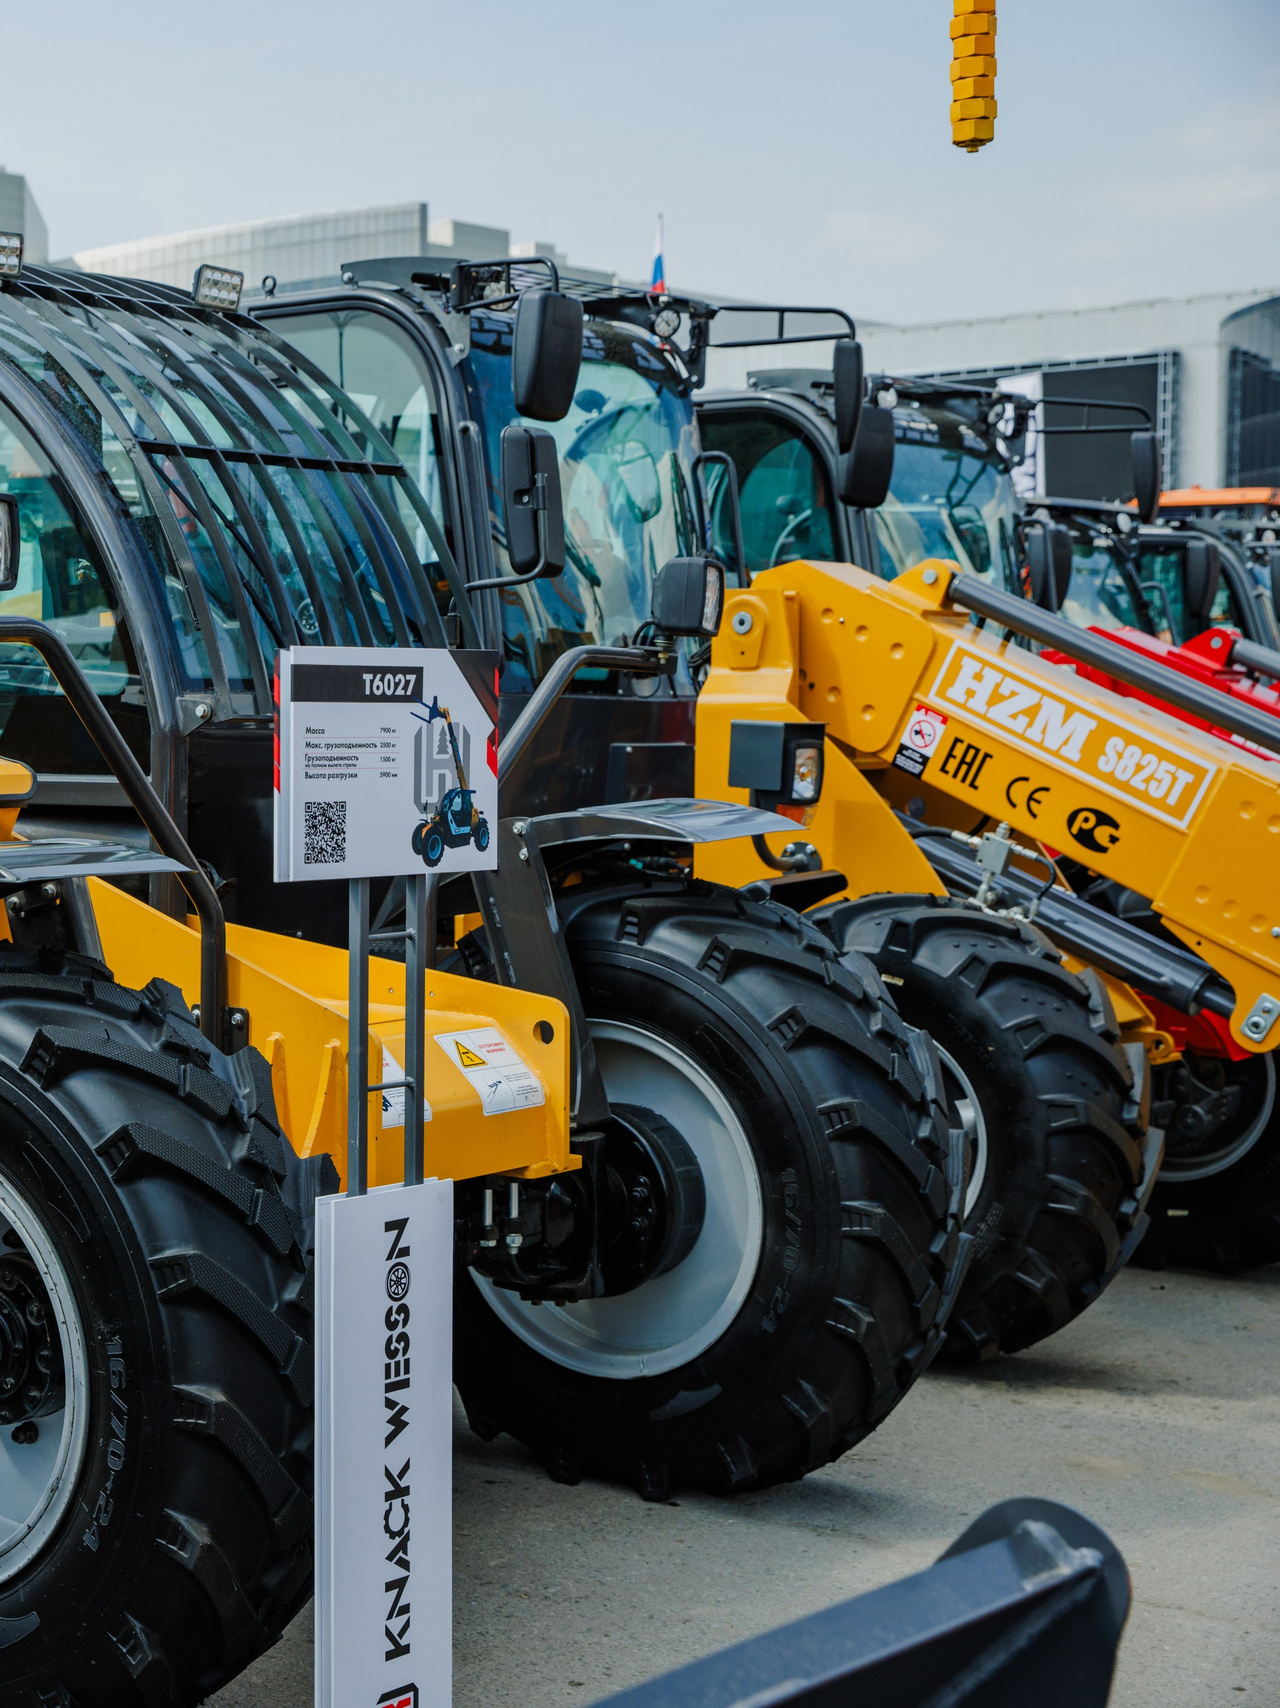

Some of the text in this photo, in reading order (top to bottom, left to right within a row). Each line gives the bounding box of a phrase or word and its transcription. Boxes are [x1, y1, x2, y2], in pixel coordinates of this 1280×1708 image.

[363, 674, 417, 696] T6027
[305, 726, 325, 735] Масса
[945, 655, 1195, 807] HZM S825T
[305, 741, 323, 749] Макс.
[304, 771, 326, 779] Высота
[81, 1335, 129, 1553] 16/70-24
[383, 1457, 412, 1663] KNACK
